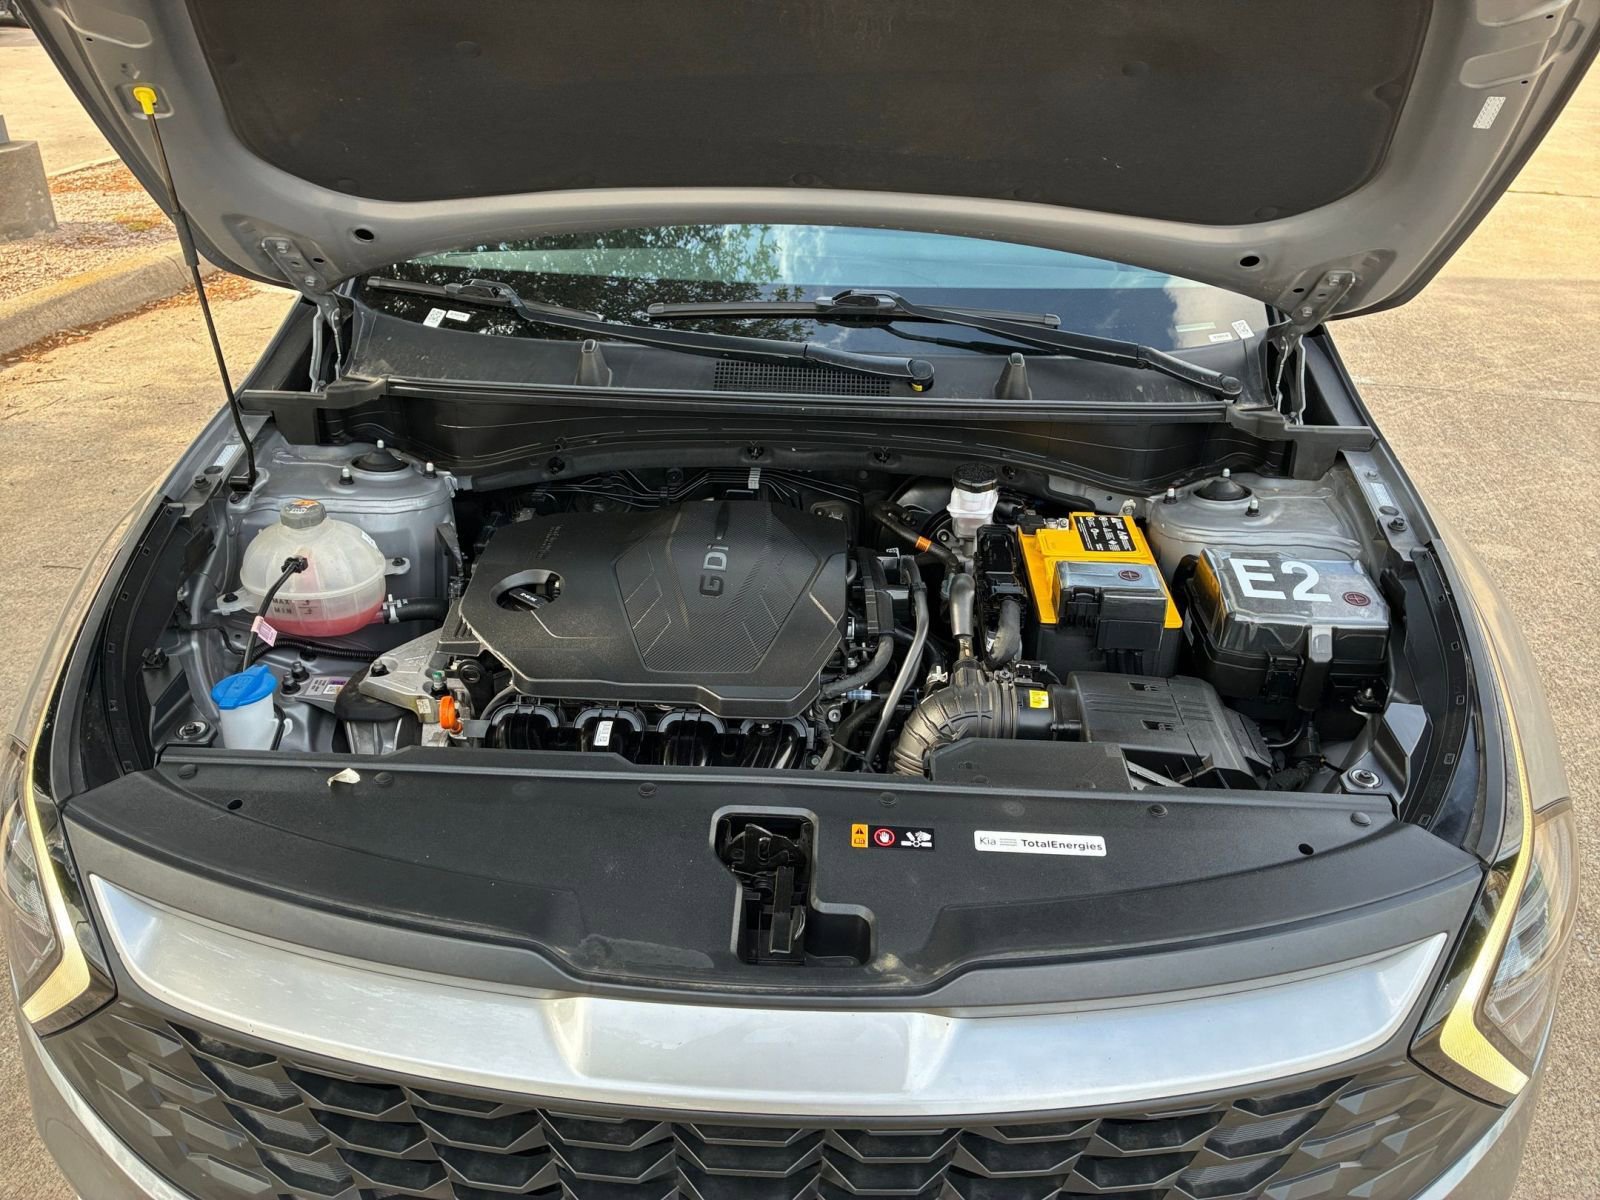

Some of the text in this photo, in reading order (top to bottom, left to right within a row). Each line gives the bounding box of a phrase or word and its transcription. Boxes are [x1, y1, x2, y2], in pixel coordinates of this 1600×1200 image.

[1229, 558, 1332, 602] E2
[979, 836, 1103, 851] Kia TotalEnergies
